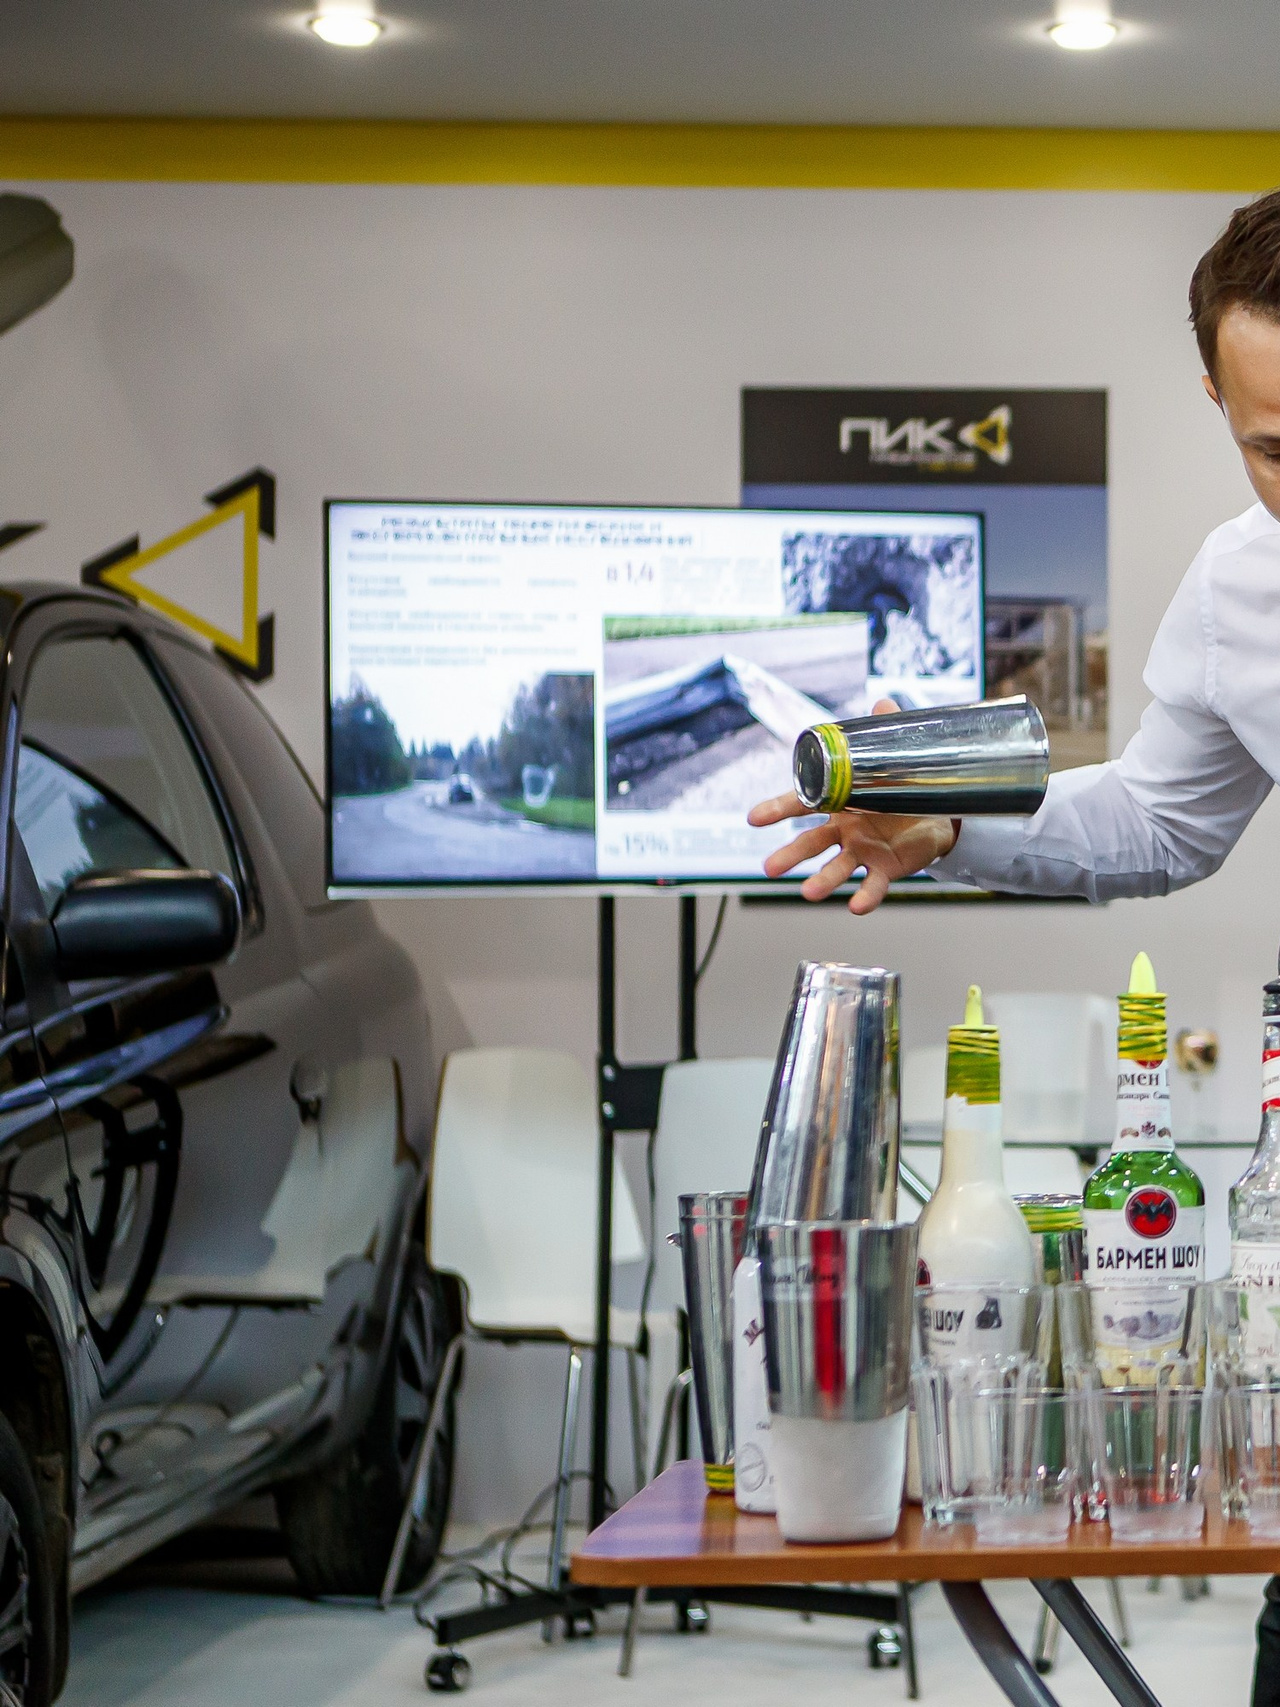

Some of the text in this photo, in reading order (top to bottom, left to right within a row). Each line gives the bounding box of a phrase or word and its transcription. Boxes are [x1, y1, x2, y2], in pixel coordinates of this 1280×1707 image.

[840, 416, 955, 453] ПИК
[1096, 1244, 1200, 1270] БАРМЕН ШОУ
